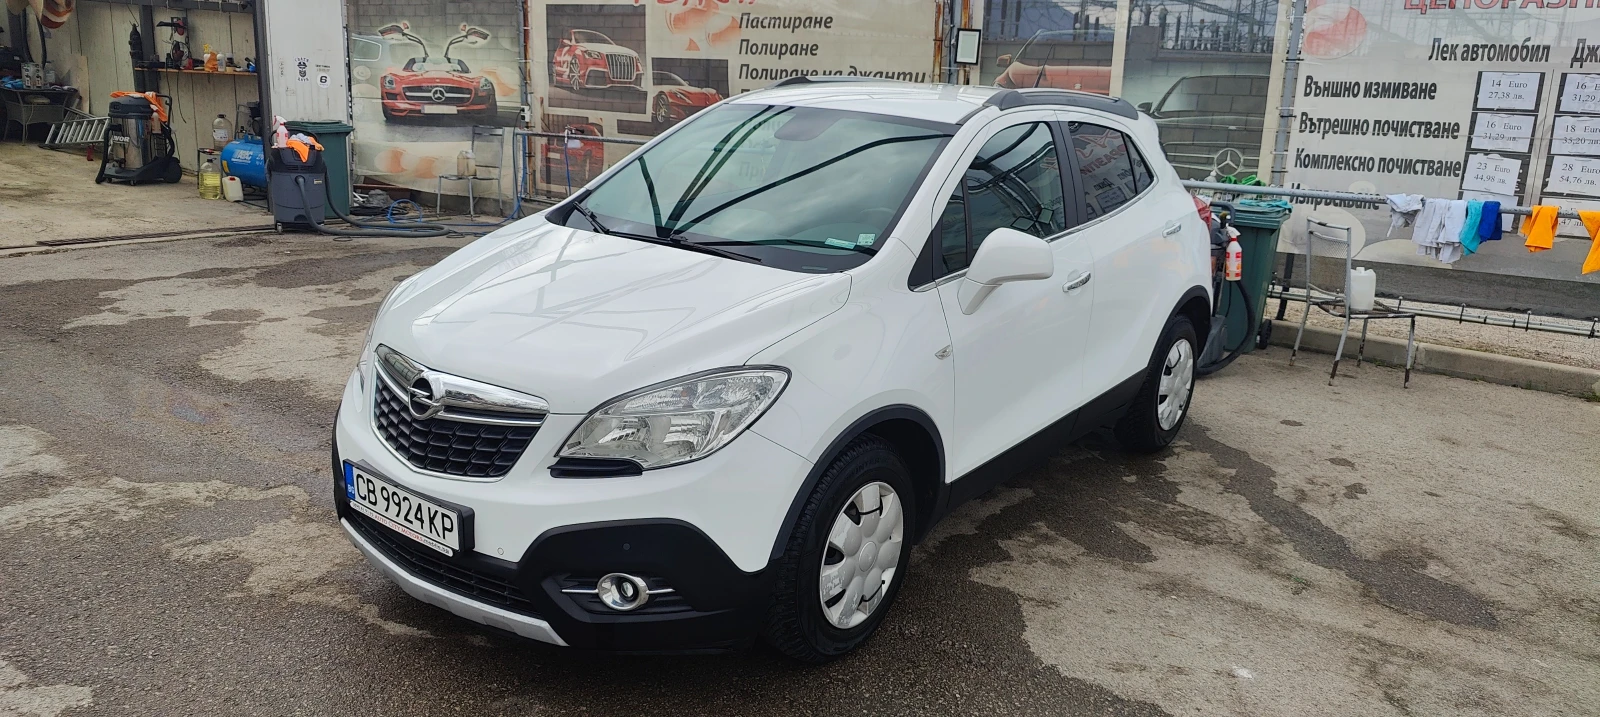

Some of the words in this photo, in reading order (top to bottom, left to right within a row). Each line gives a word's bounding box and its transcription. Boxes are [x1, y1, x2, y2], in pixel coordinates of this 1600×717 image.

[739, 12, 834, 33] Пастиране
[739, 39, 819, 59] Полиране
[1428, 37, 1459, 61] Лек
[1460, 36, 1550, 63] автомобил
[1570, 38, 1600, 69] Дж
[320, 75, 328, 84] 6
[1491, 79, 1502, 87] 14
[1508, 80, 1528, 88] Euro
[1303, 75, 1361, 98] Външно
[1362, 81, 1437, 100] измиване
[1576, 81, 1587, 90] 16
[1488, 91, 1511, 100] 27,38
[1572, 94, 1596, 102] 31,29
[1299, 111, 1369, 139] Вътрешно
[1372, 119, 1460, 139] почистване
[1486, 120, 1497, 129] 16
[1503, 122, 1522, 131] Euro
[1565, 124, 1576, 133] 18
[1483, 132, 1505, 141] 31,29
[1562, 136, 1586, 145] 35,20
[1294, 148, 1375, 172] Комплексно
[1377, 156, 1462, 177] почистване
[1476, 162, 1488, 170] 23
[1494, 164, 1511, 173] Euro
[1561, 163, 1574, 171] 28
[1581, 165, 1600, 174] Euro
[1473, 173, 1496, 182] 44,98
[1559, 175, 1582, 184] 54,76
[347, 483, 355, 495] BG
[356, 473, 378, 506] CB
[380, 486, 425, 530] 9924
[427, 506, 454, 540] KP
